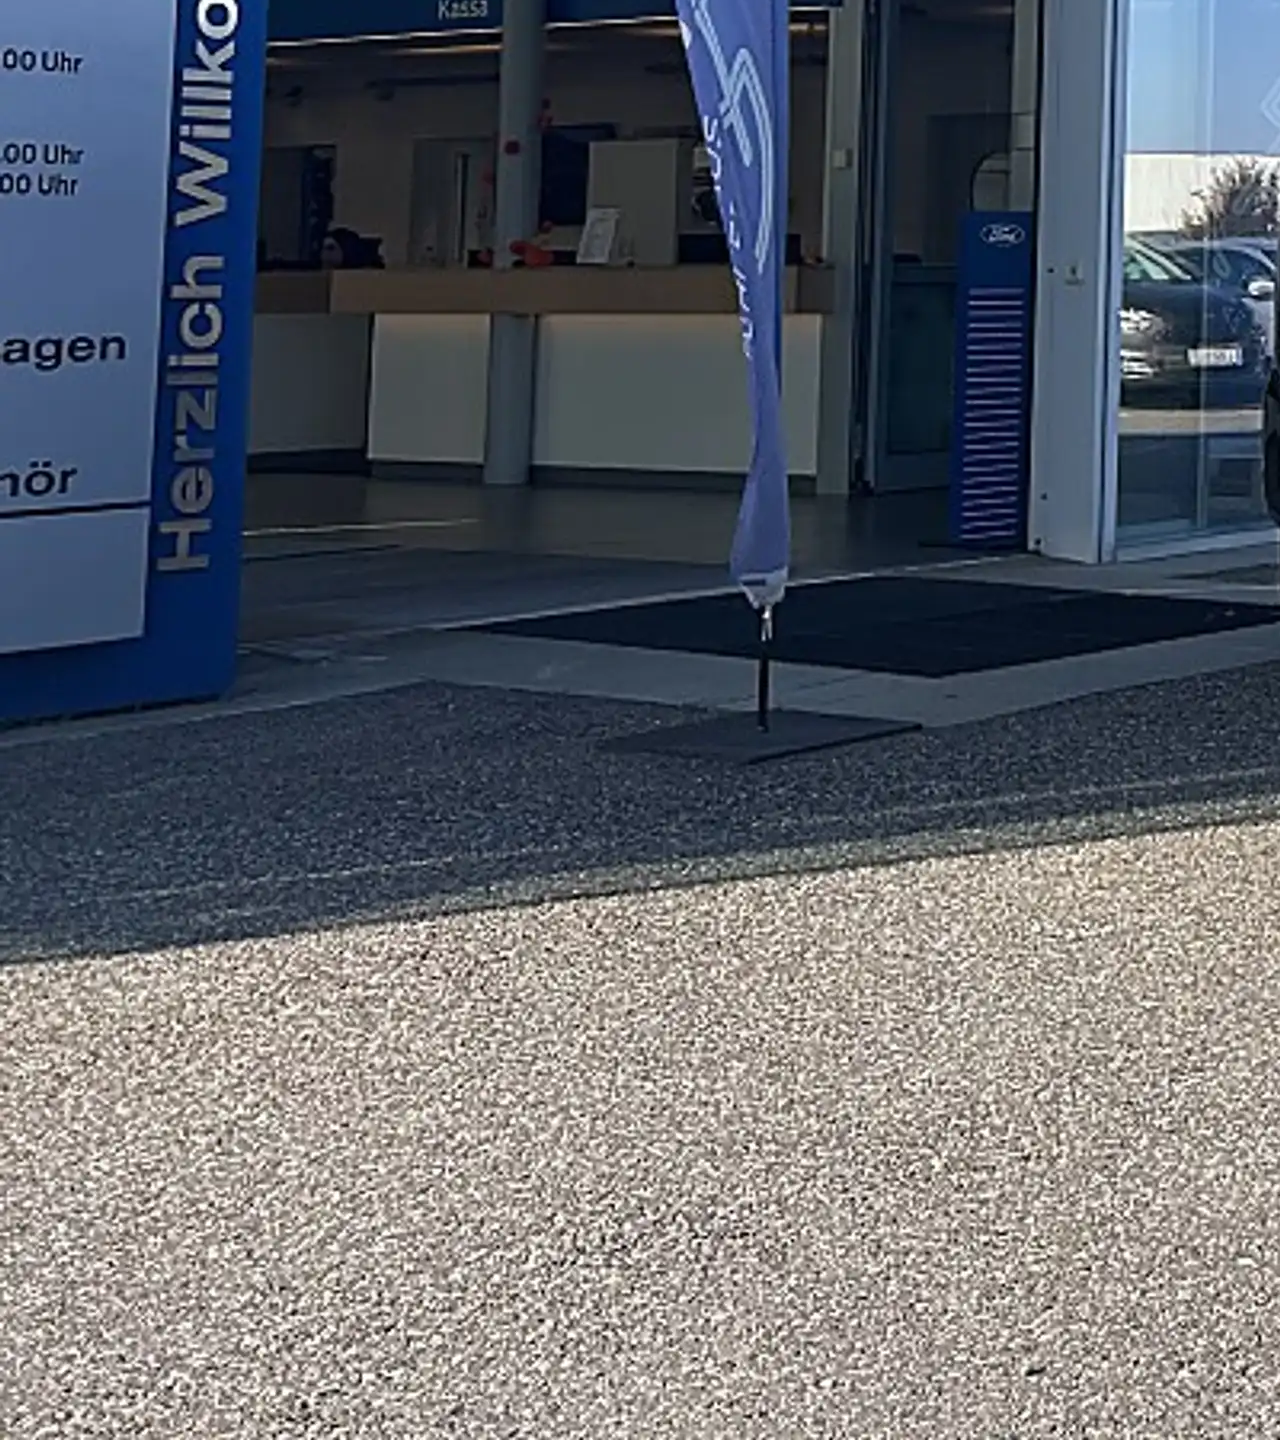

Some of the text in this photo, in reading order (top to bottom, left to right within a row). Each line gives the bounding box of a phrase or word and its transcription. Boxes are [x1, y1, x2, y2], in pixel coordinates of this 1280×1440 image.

[41, 50, 84, 74] Uhr
[44, 143, 85, 165] Uhr
[38, 173, 78, 196] Uhr
[2, 335, 126, 371] agen
[157, 255, 225, 572] Herzlich
